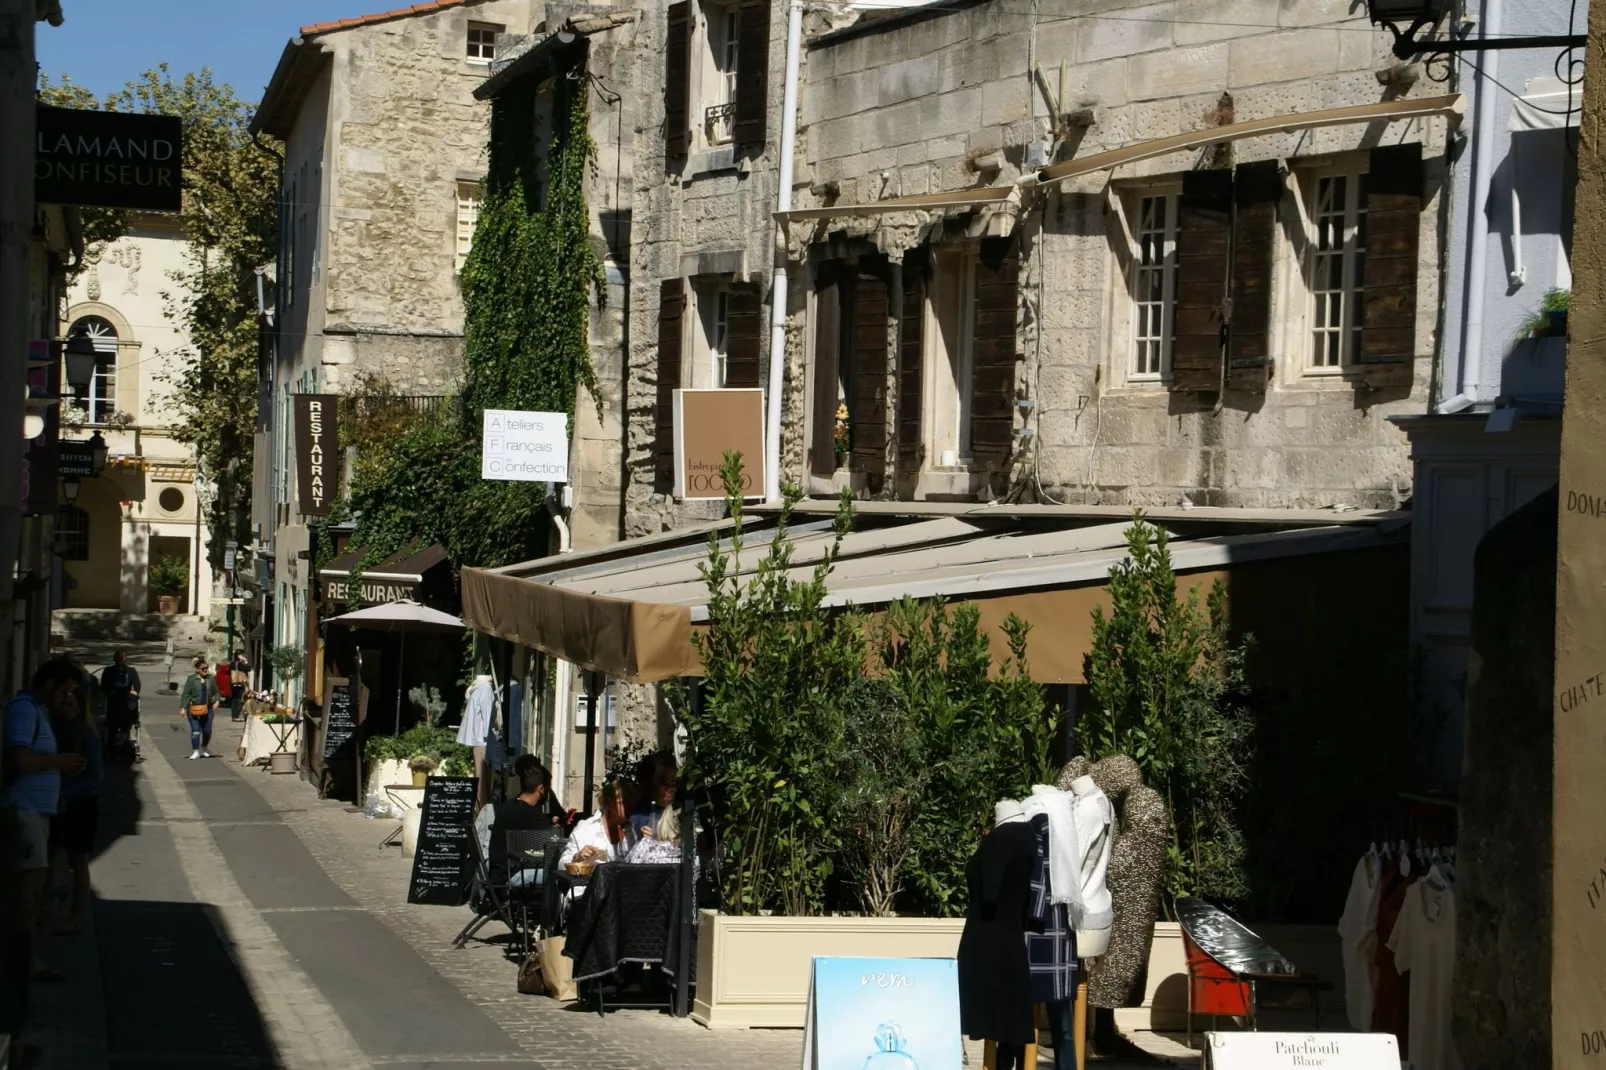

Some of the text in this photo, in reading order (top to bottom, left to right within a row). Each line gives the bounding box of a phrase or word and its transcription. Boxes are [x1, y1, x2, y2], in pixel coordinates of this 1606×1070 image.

[309, 401, 325, 508] RESTAURANT
[326, 582, 415, 602] RESAURANT
[1275, 1040, 1340, 1054] Patchouli
[1292, 1055, 1325, 1066] Blanc
